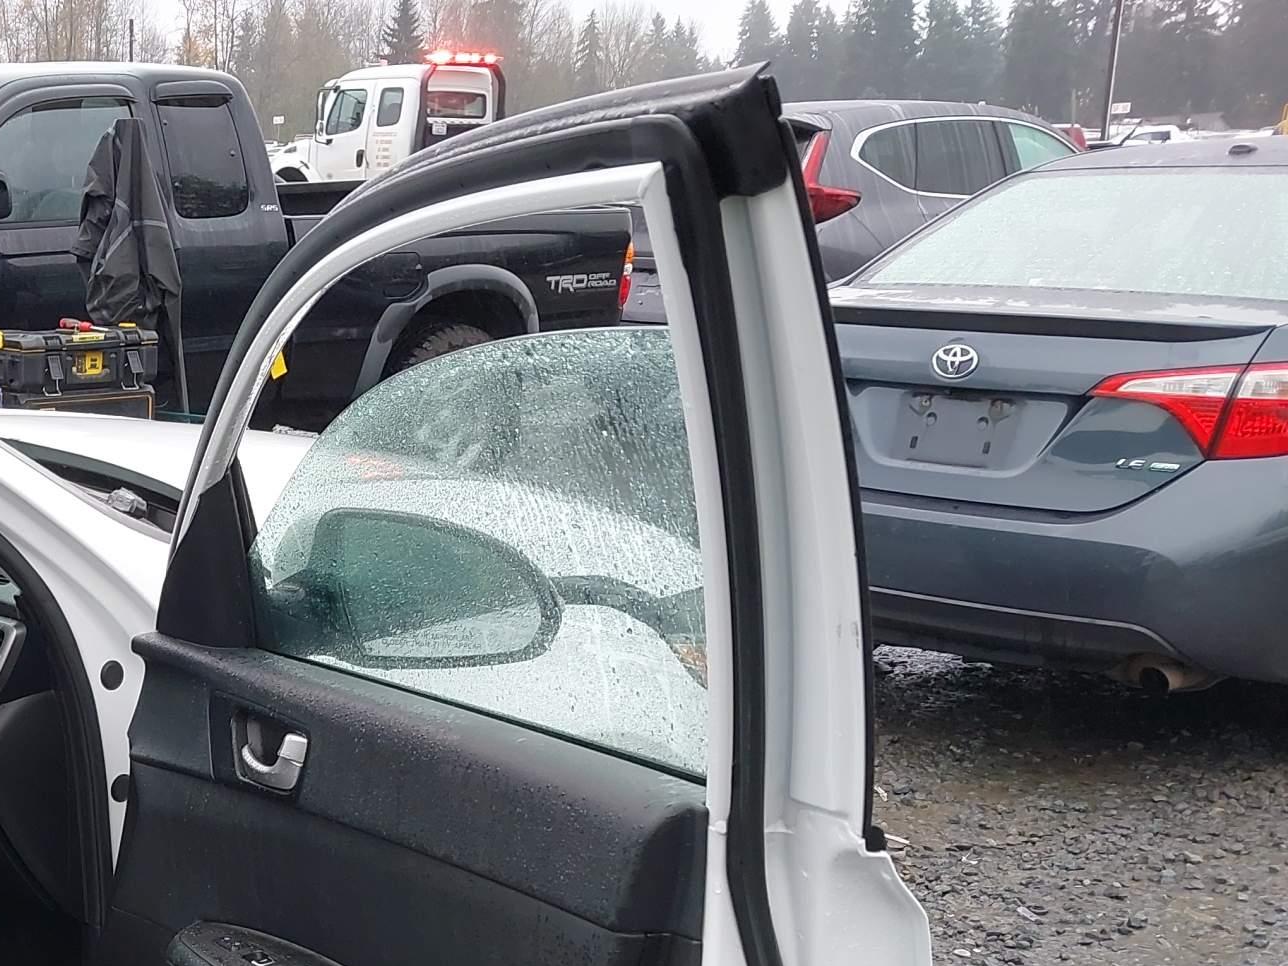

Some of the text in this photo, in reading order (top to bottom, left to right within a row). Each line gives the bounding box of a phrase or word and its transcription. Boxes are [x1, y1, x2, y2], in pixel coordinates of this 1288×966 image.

[546, 272, 611, 294] TRD OFF
[587, 279, 617, 288] ROAD
[1115, 458, 1147, 471] LE
